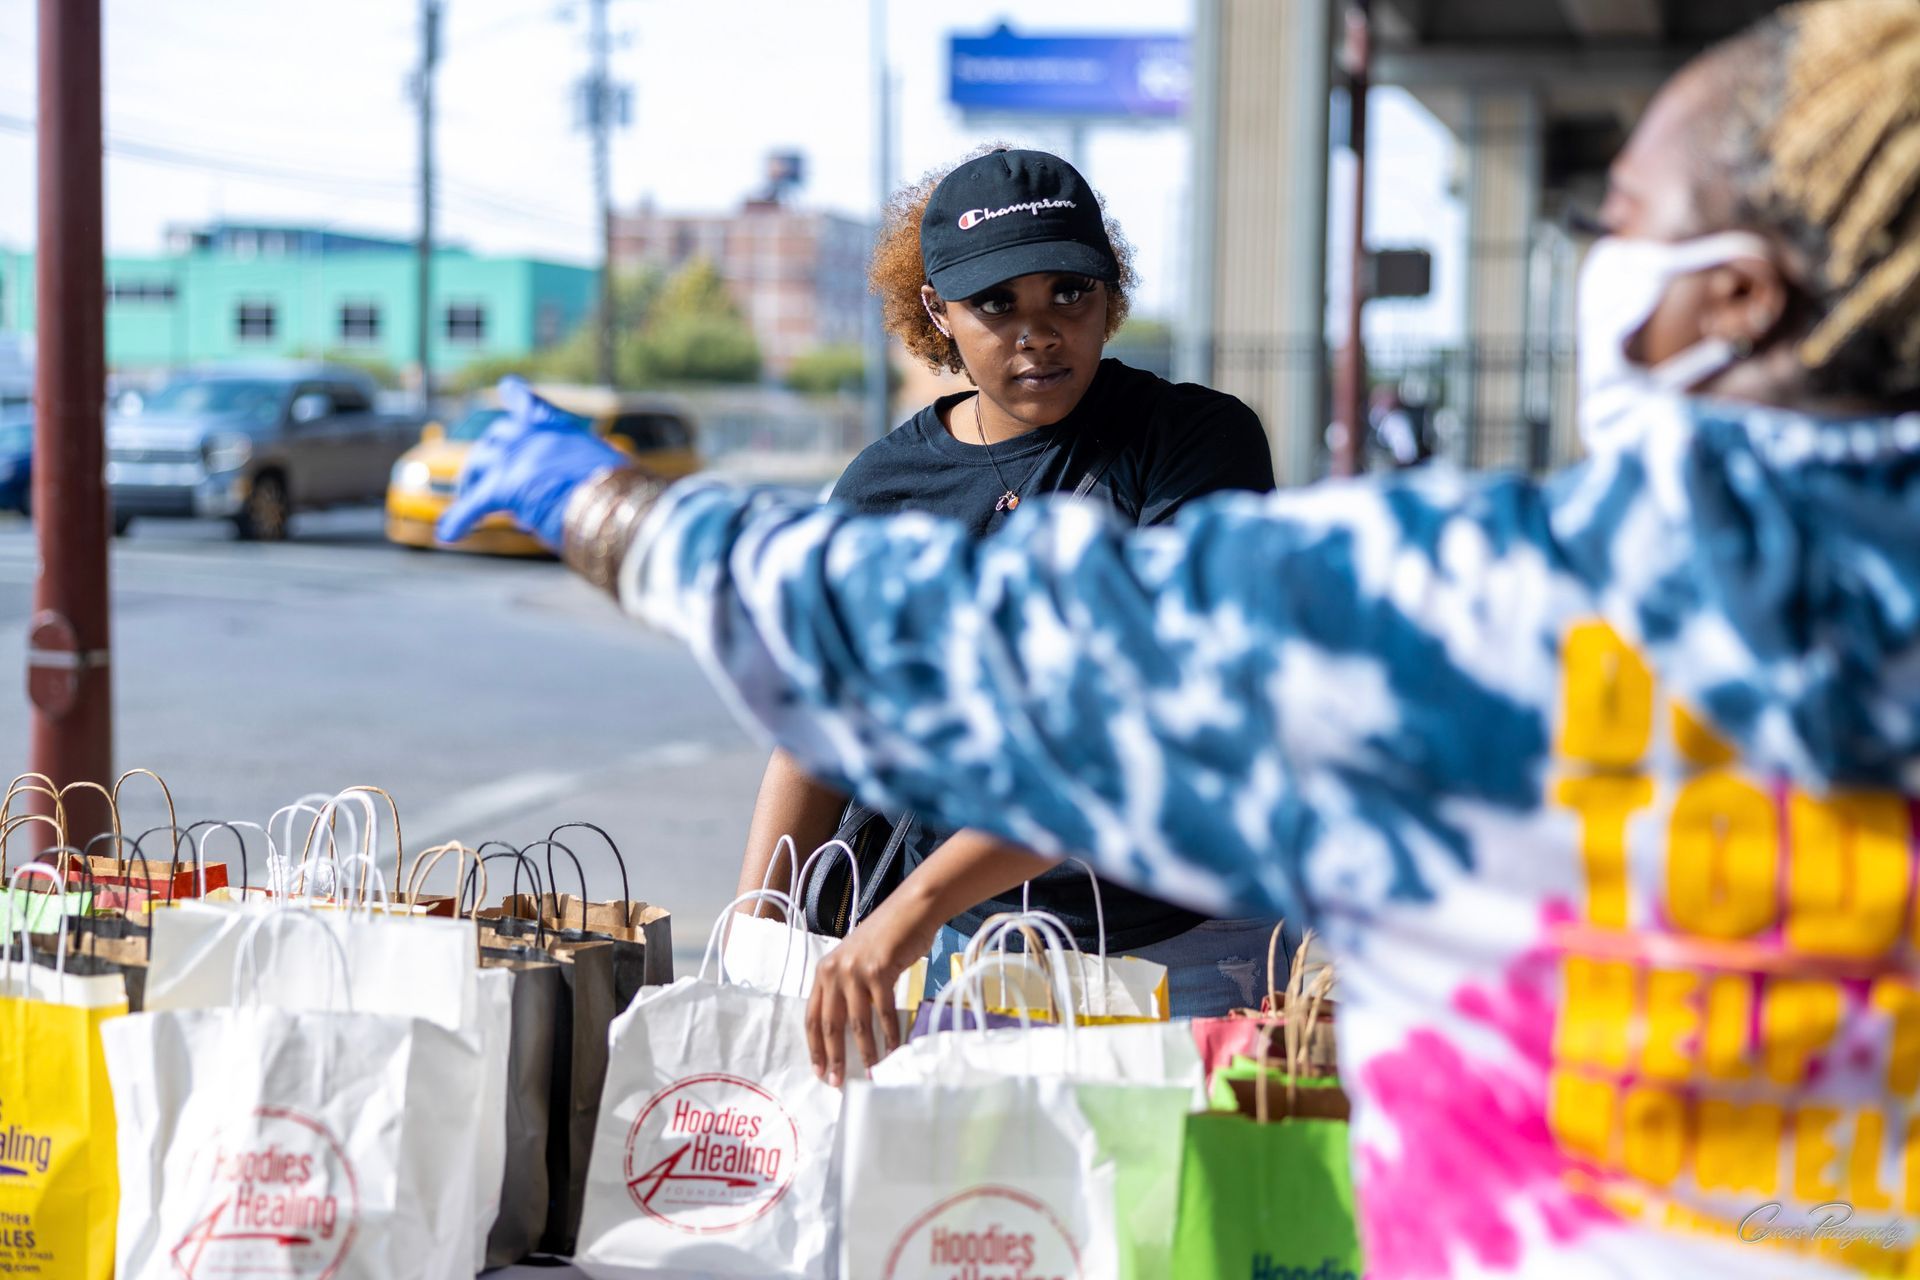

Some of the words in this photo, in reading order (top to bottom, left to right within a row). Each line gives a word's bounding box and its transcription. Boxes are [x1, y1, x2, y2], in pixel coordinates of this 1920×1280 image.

[958, 199, 1076, 230] Champion
[672, 1098, 762, 1138] Hoodies
[690, 1135, 781, 1182] Healing
[234, 1184, 337, 1239] Healing
[0, 1229, 36, 1249] LES
[931, 1223, 1035, 1269] Hoodies
